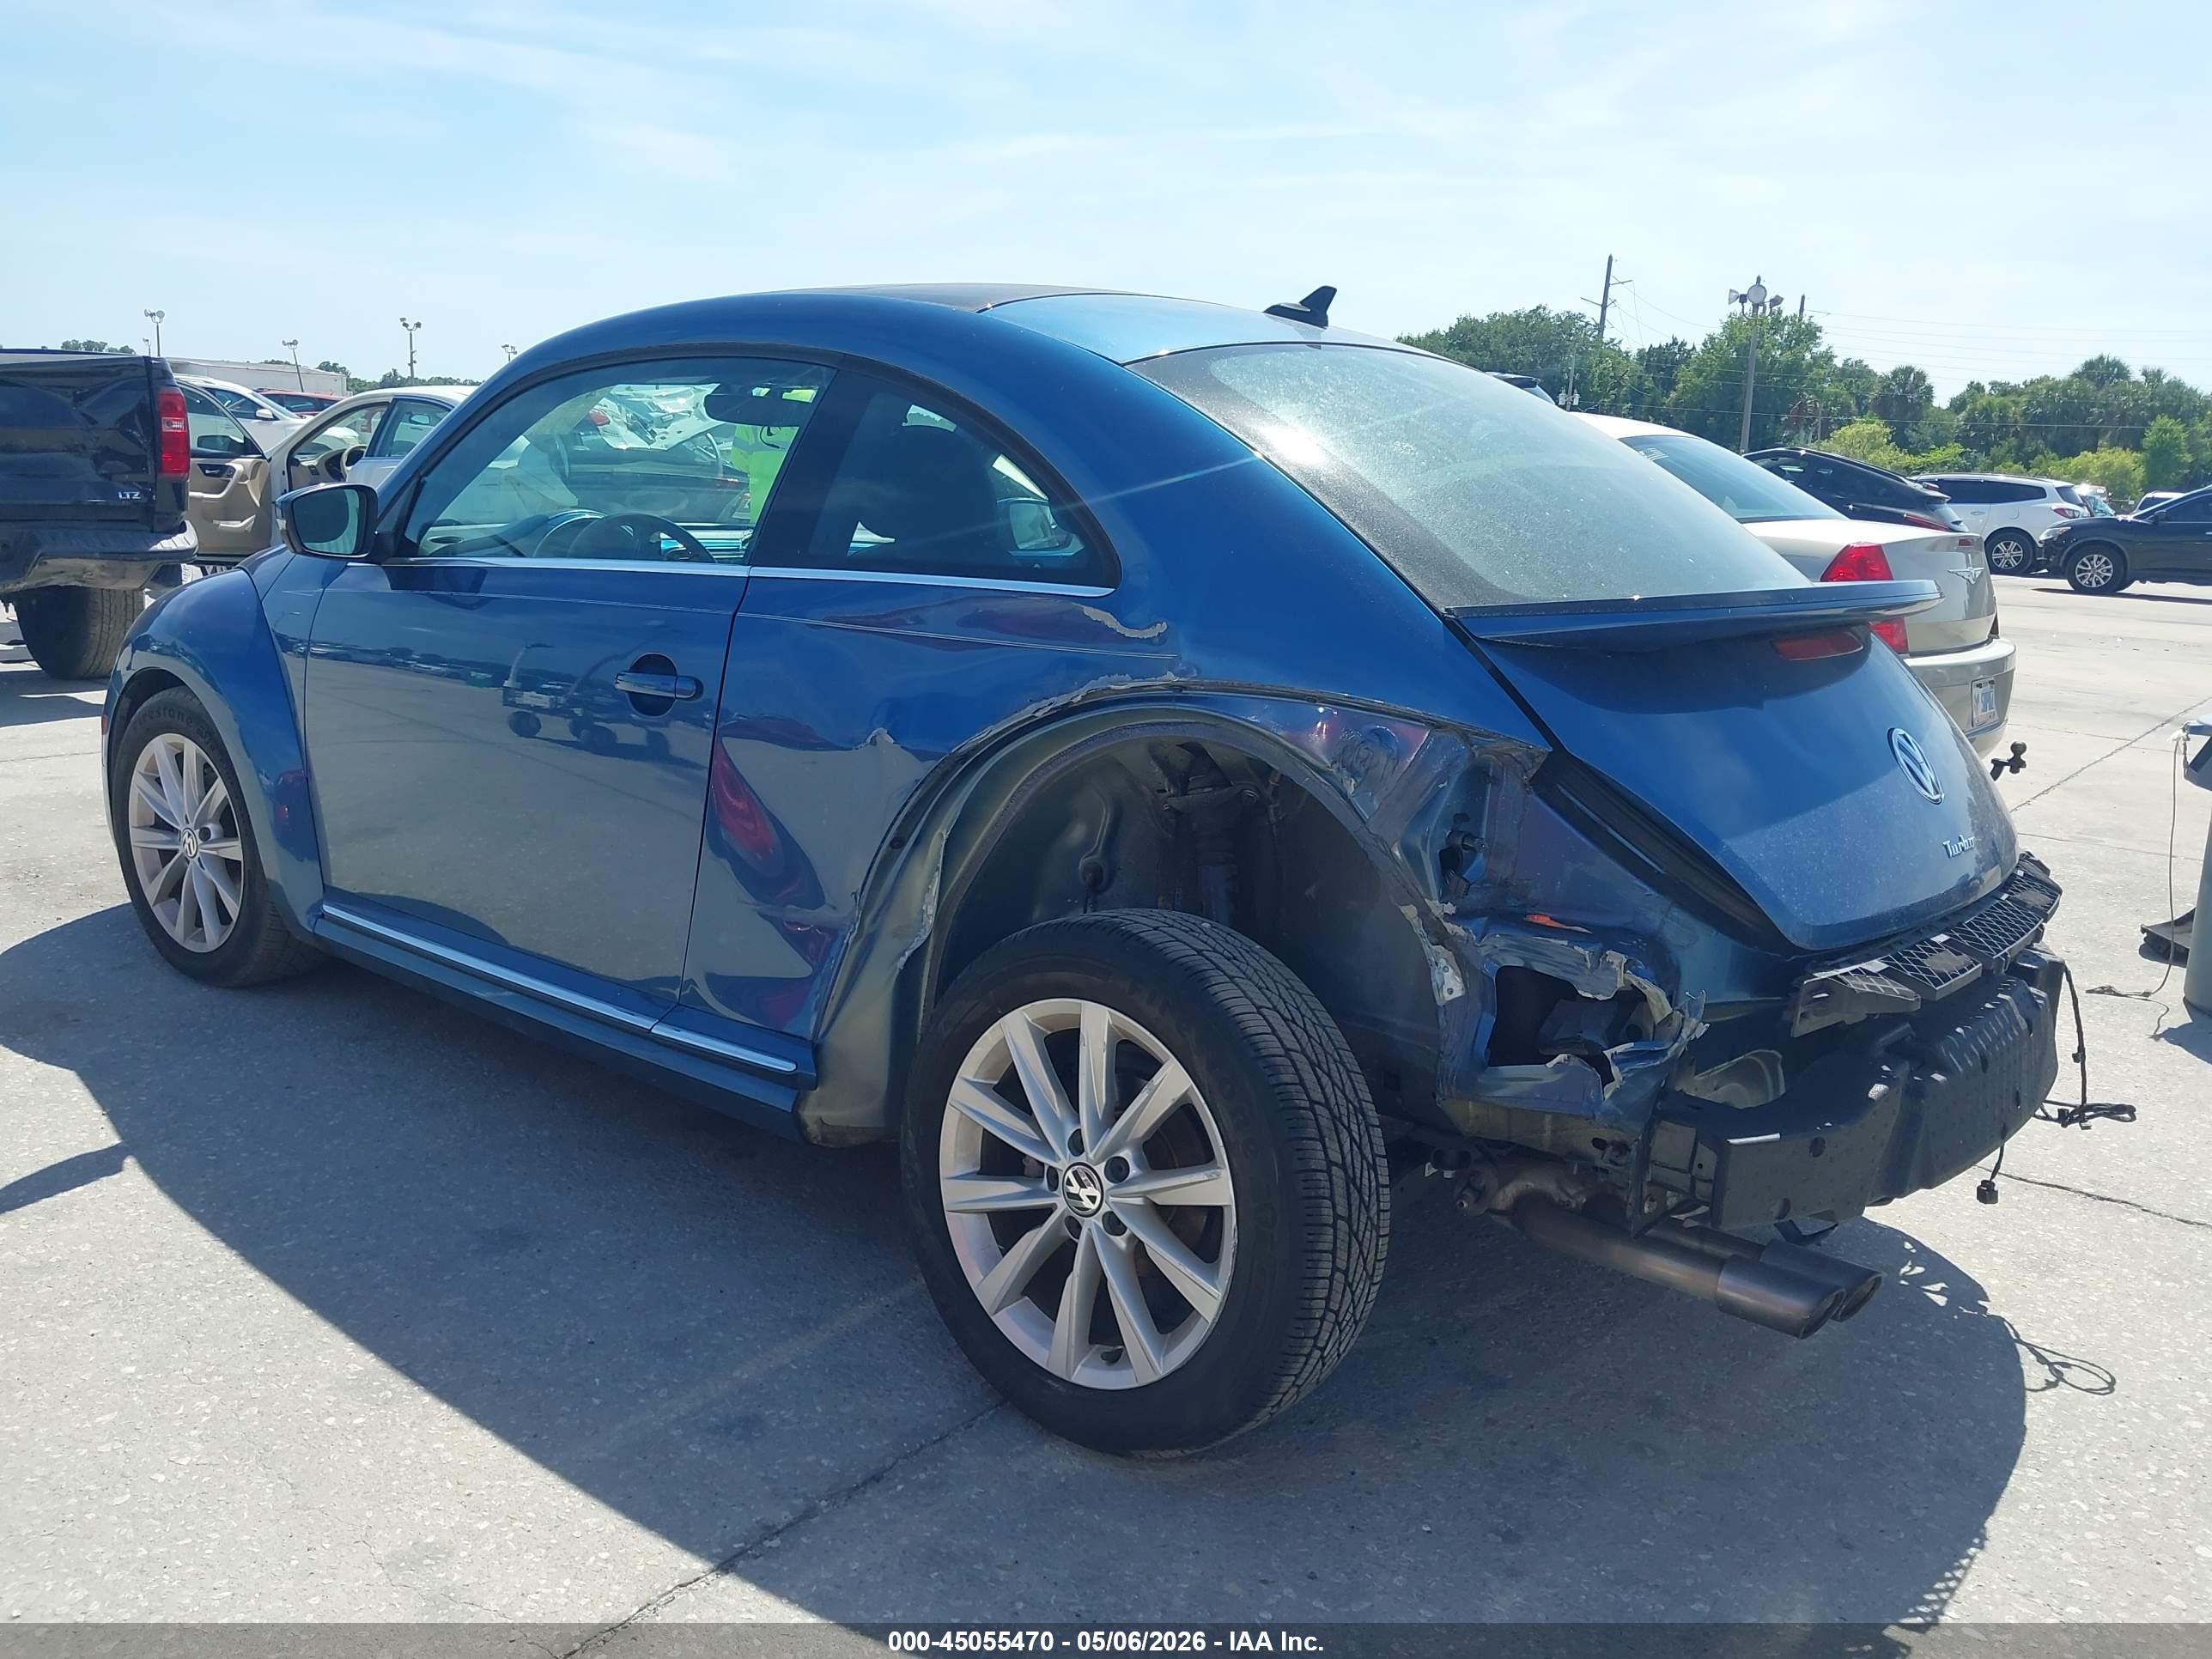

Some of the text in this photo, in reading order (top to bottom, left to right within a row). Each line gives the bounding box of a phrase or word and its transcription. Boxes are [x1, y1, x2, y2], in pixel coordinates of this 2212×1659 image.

[118, 490, 142, 500] LTZ
[132, 706, 193, 730] irestone
[1942, 834, 1976, 858] Turbo
